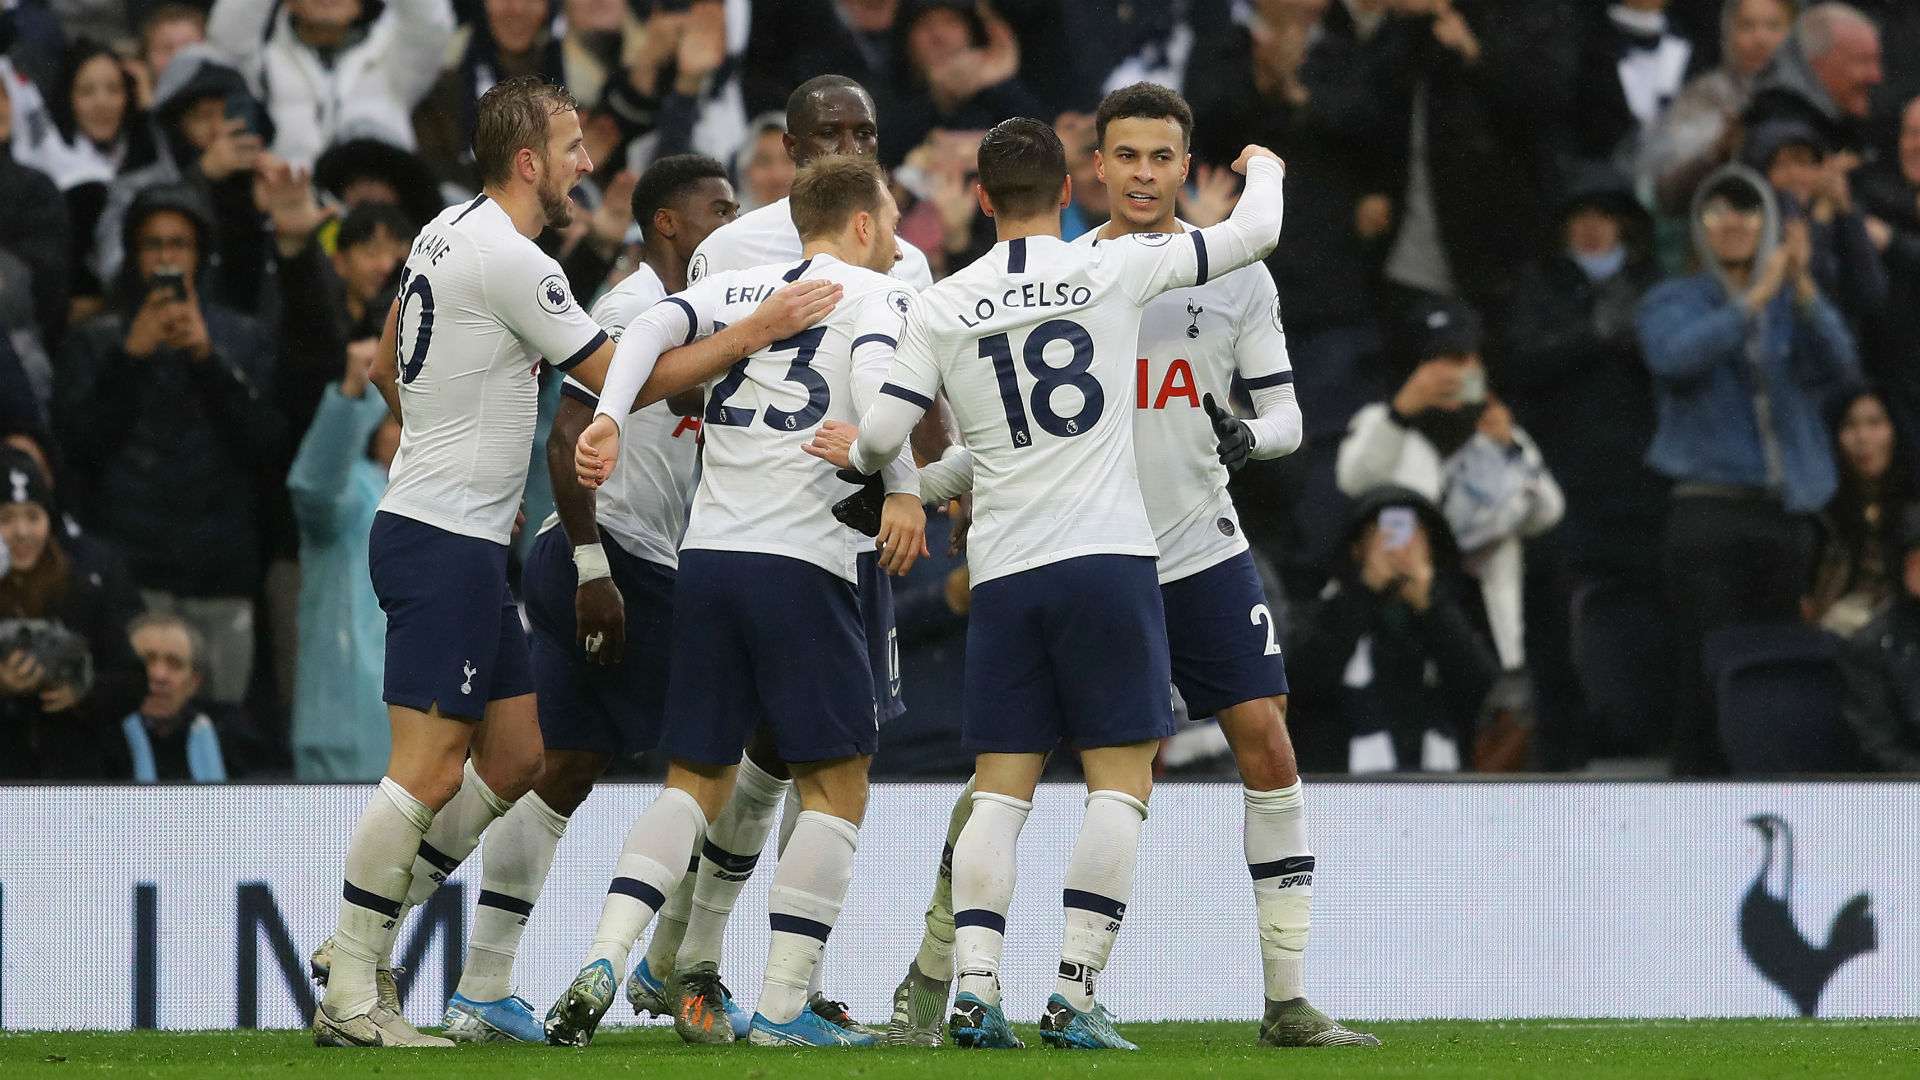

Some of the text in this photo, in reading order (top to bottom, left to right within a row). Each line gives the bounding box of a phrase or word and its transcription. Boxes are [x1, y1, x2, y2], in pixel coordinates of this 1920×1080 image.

[413, 233, 451, 267] KANE
[957, 281, 1092, 329] LO CELSO
[704, 320, 831, 432] 23
[977, 318, 1105, 450] 18
